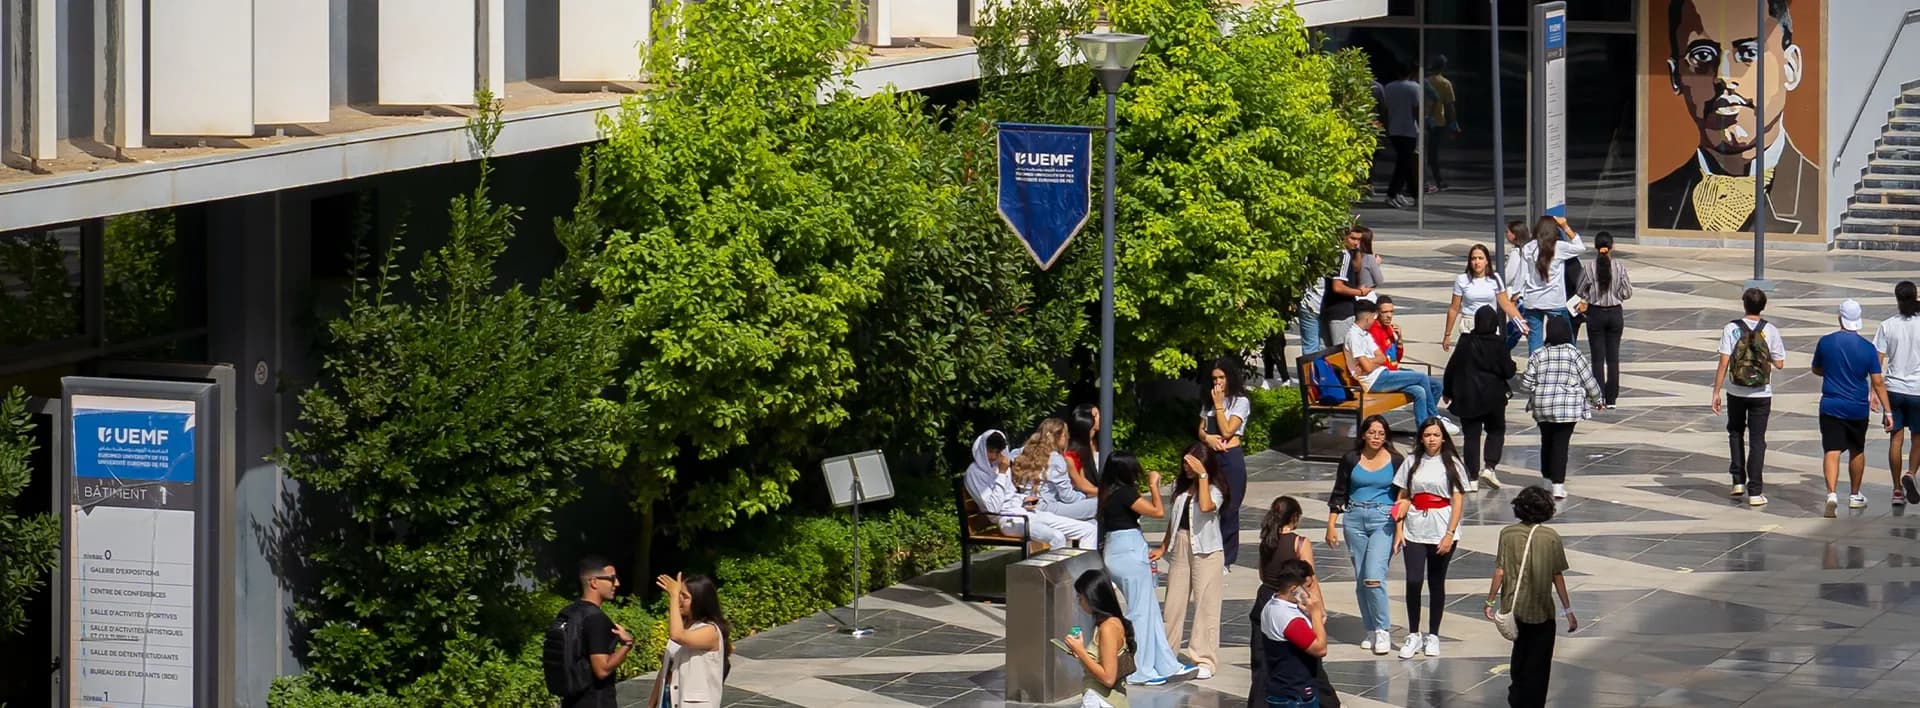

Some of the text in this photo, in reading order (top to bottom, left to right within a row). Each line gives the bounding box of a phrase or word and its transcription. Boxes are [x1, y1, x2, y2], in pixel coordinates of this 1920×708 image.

[1028, 153, 1074, 166] UEMF
[114, 427, 168, 445] UEMF
[84, 485, 167, 504] BÂTIMENT 1
[104, 549, 112, 560] 0
[90, 566, 160, 576] GALERIE D'EXPOSITIONS
[90, 587, 113, 595] CENTRE
[114, 588, 122, 596] DE
[90, 608, 177, 620] SALLE D'ACTIVITÉS SPORTIVES
[109, 625, 144, 634] D'ACTIVITÉS
[145, 628, 183, 637] ARTISTIQUES
[90, 668, 114, 676] BUREAU
[104, 691, 108, 702] 1
